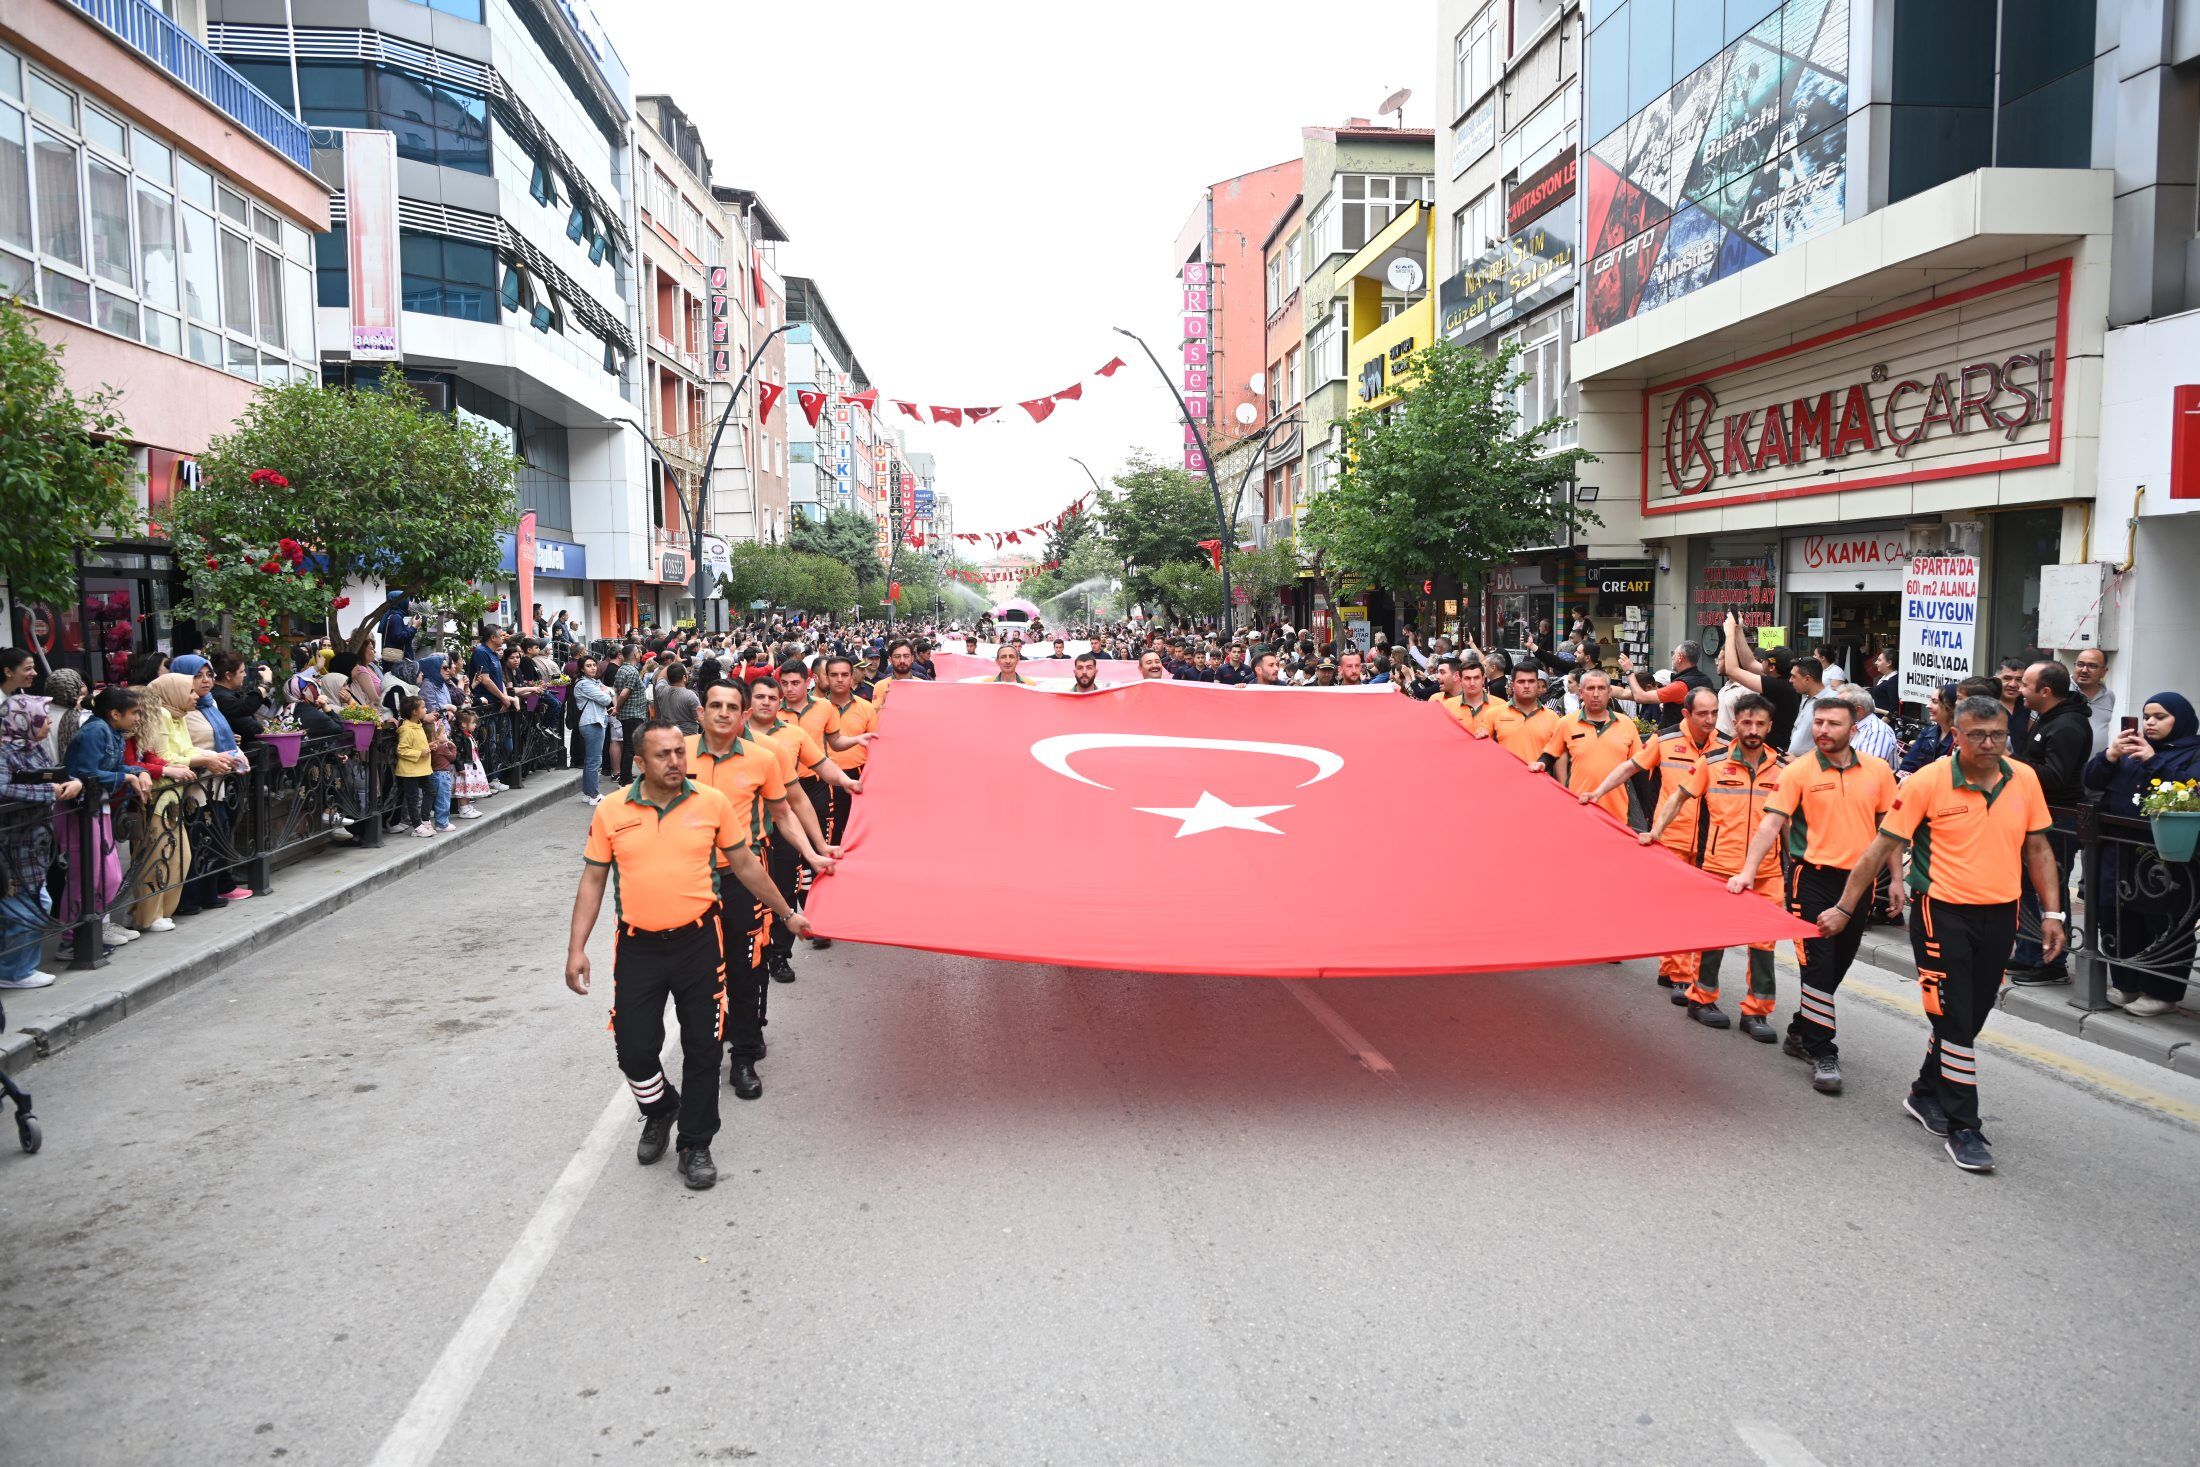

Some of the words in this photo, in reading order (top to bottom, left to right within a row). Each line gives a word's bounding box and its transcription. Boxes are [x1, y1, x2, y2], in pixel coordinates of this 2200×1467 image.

[1702, 96, 1780, 165] Bianchi
[1594, 228, 1655, 275] carraro
[711, 268, 728, 371] OTEL
[1723, 383, 1881, 476] KAMA
[1885, 349, 2052, 458] ÇARŞI
[1826, 541, 1881, 564] KAMA
[1884, 542, 1904, 565] ÇA
[1912, 556, 1974, 576] ISPARTA'DA
[1601, 580, 1651, 593] CREART
[1939, 581, 1976, 598] ALANLA
[1926, 601, 1974, 622] UYGUN
